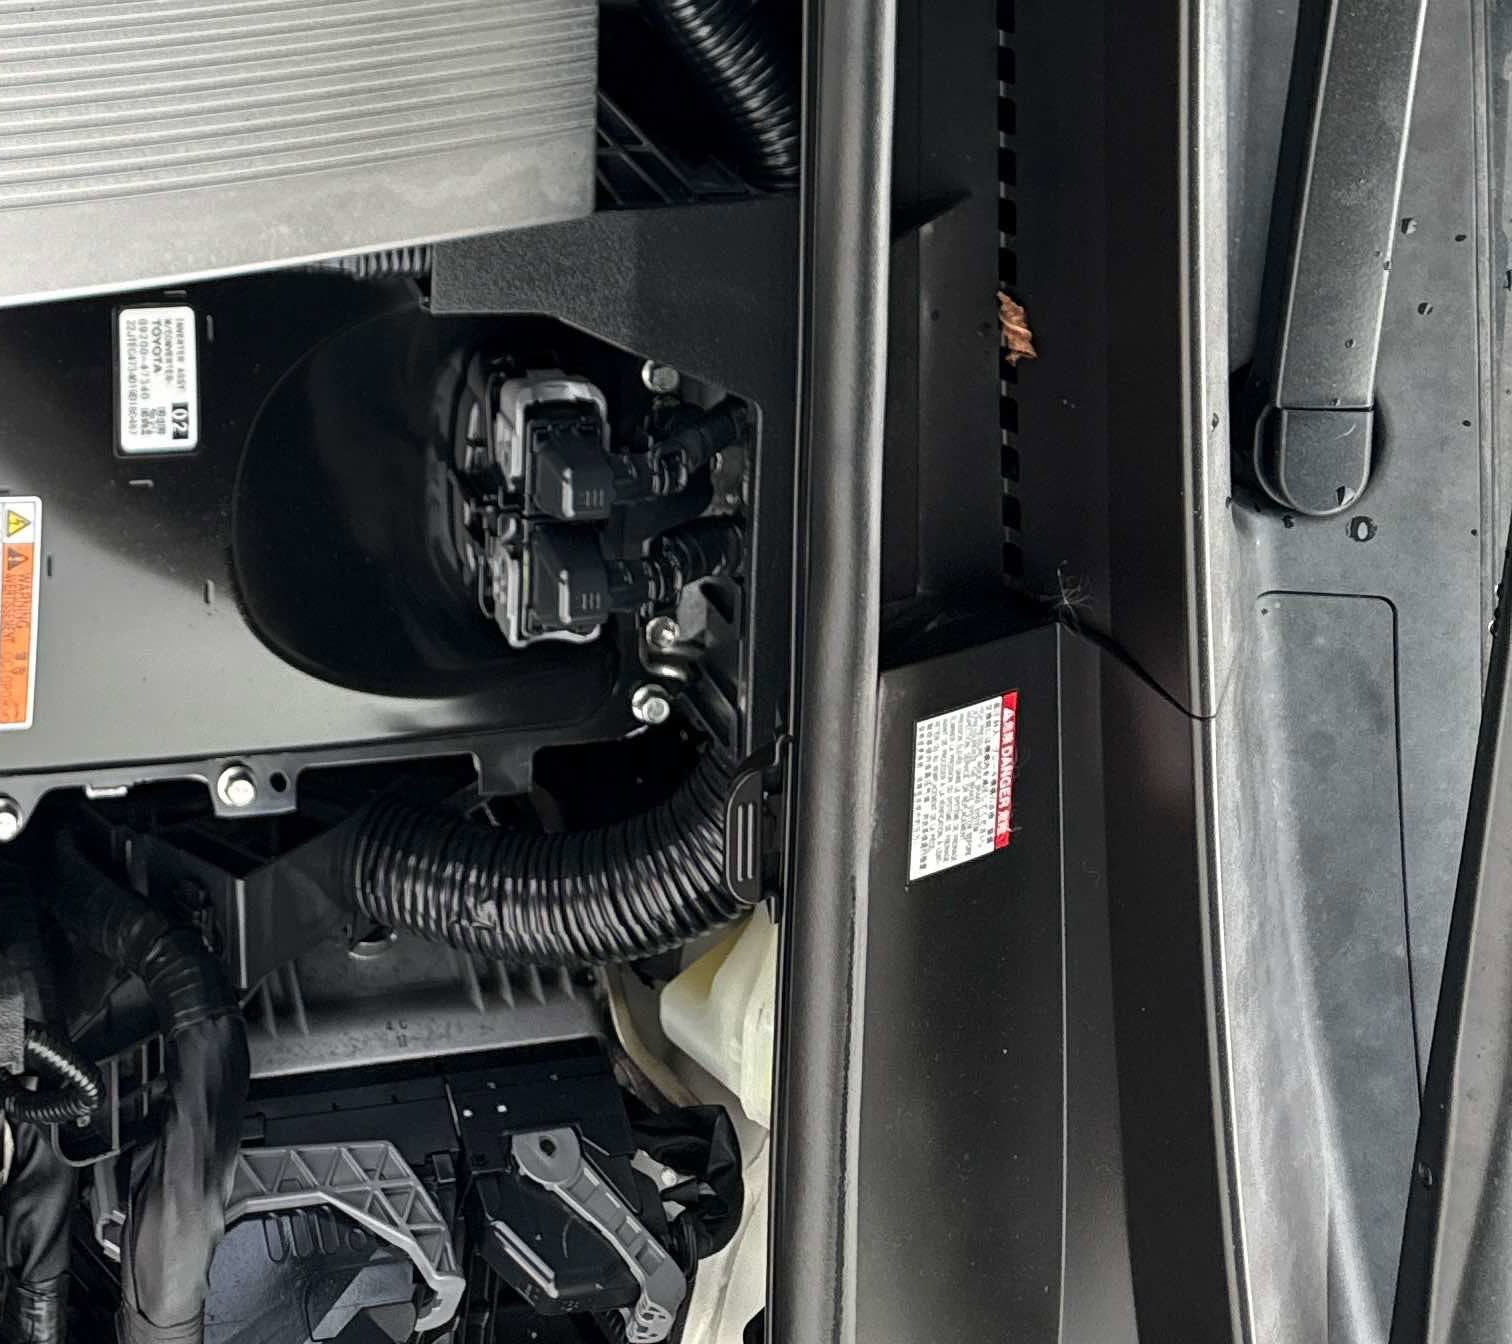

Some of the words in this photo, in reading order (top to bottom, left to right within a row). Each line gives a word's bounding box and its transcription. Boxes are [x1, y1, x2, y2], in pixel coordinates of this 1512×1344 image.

[152, 319, 163, 374] TOYOTA
[175, 318, 185, 363] INVERTER
[172, 407, 189, 432] 02
[16, 572, 32, 630] WARNING
[998, 745, 1014, 808] DANGER
